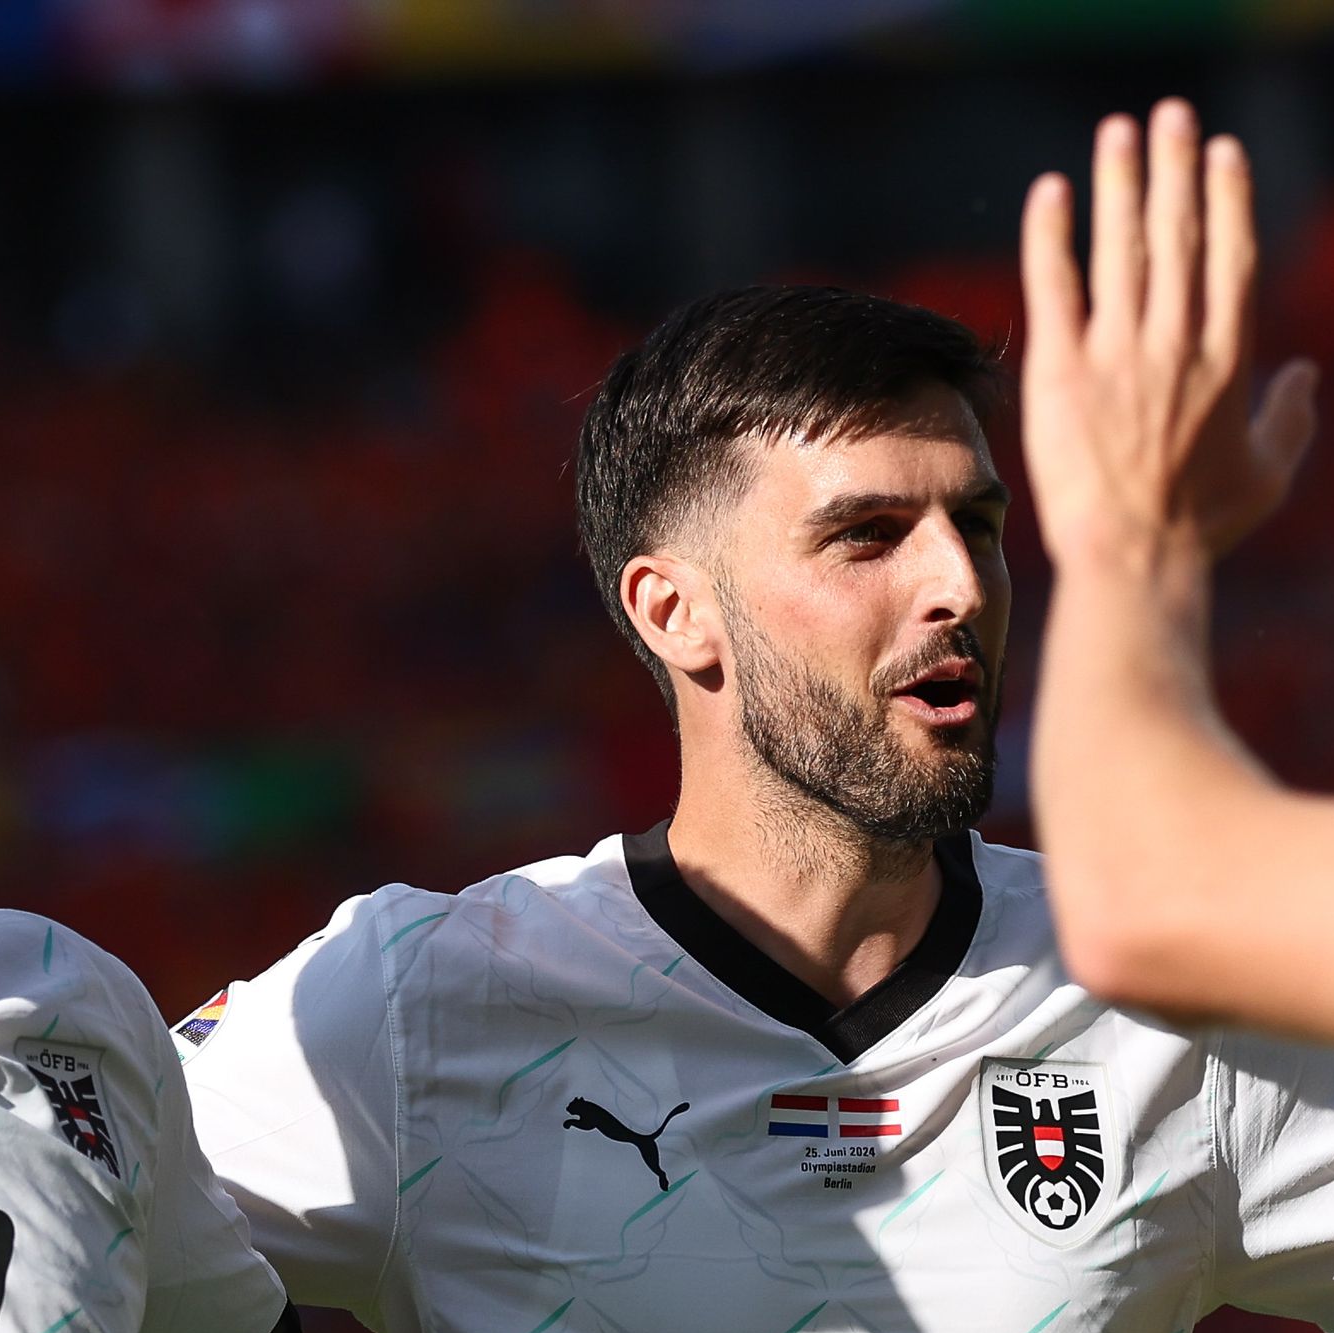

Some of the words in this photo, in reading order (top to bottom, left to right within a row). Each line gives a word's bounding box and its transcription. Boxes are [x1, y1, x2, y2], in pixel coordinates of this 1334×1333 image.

[40, 1049, 75, 1072] ÖFB
[1016, 1068, 1068, 1088] ÖFB
[805, 1147, 821, 1158] 25.
[824, 1147, 847, 1157] Juni
[850, 1147, 876, 1157] 2024
[801, 1162, 876, 1174] Olympiastadion
[824, 1177, 853, 1189] Berlin
